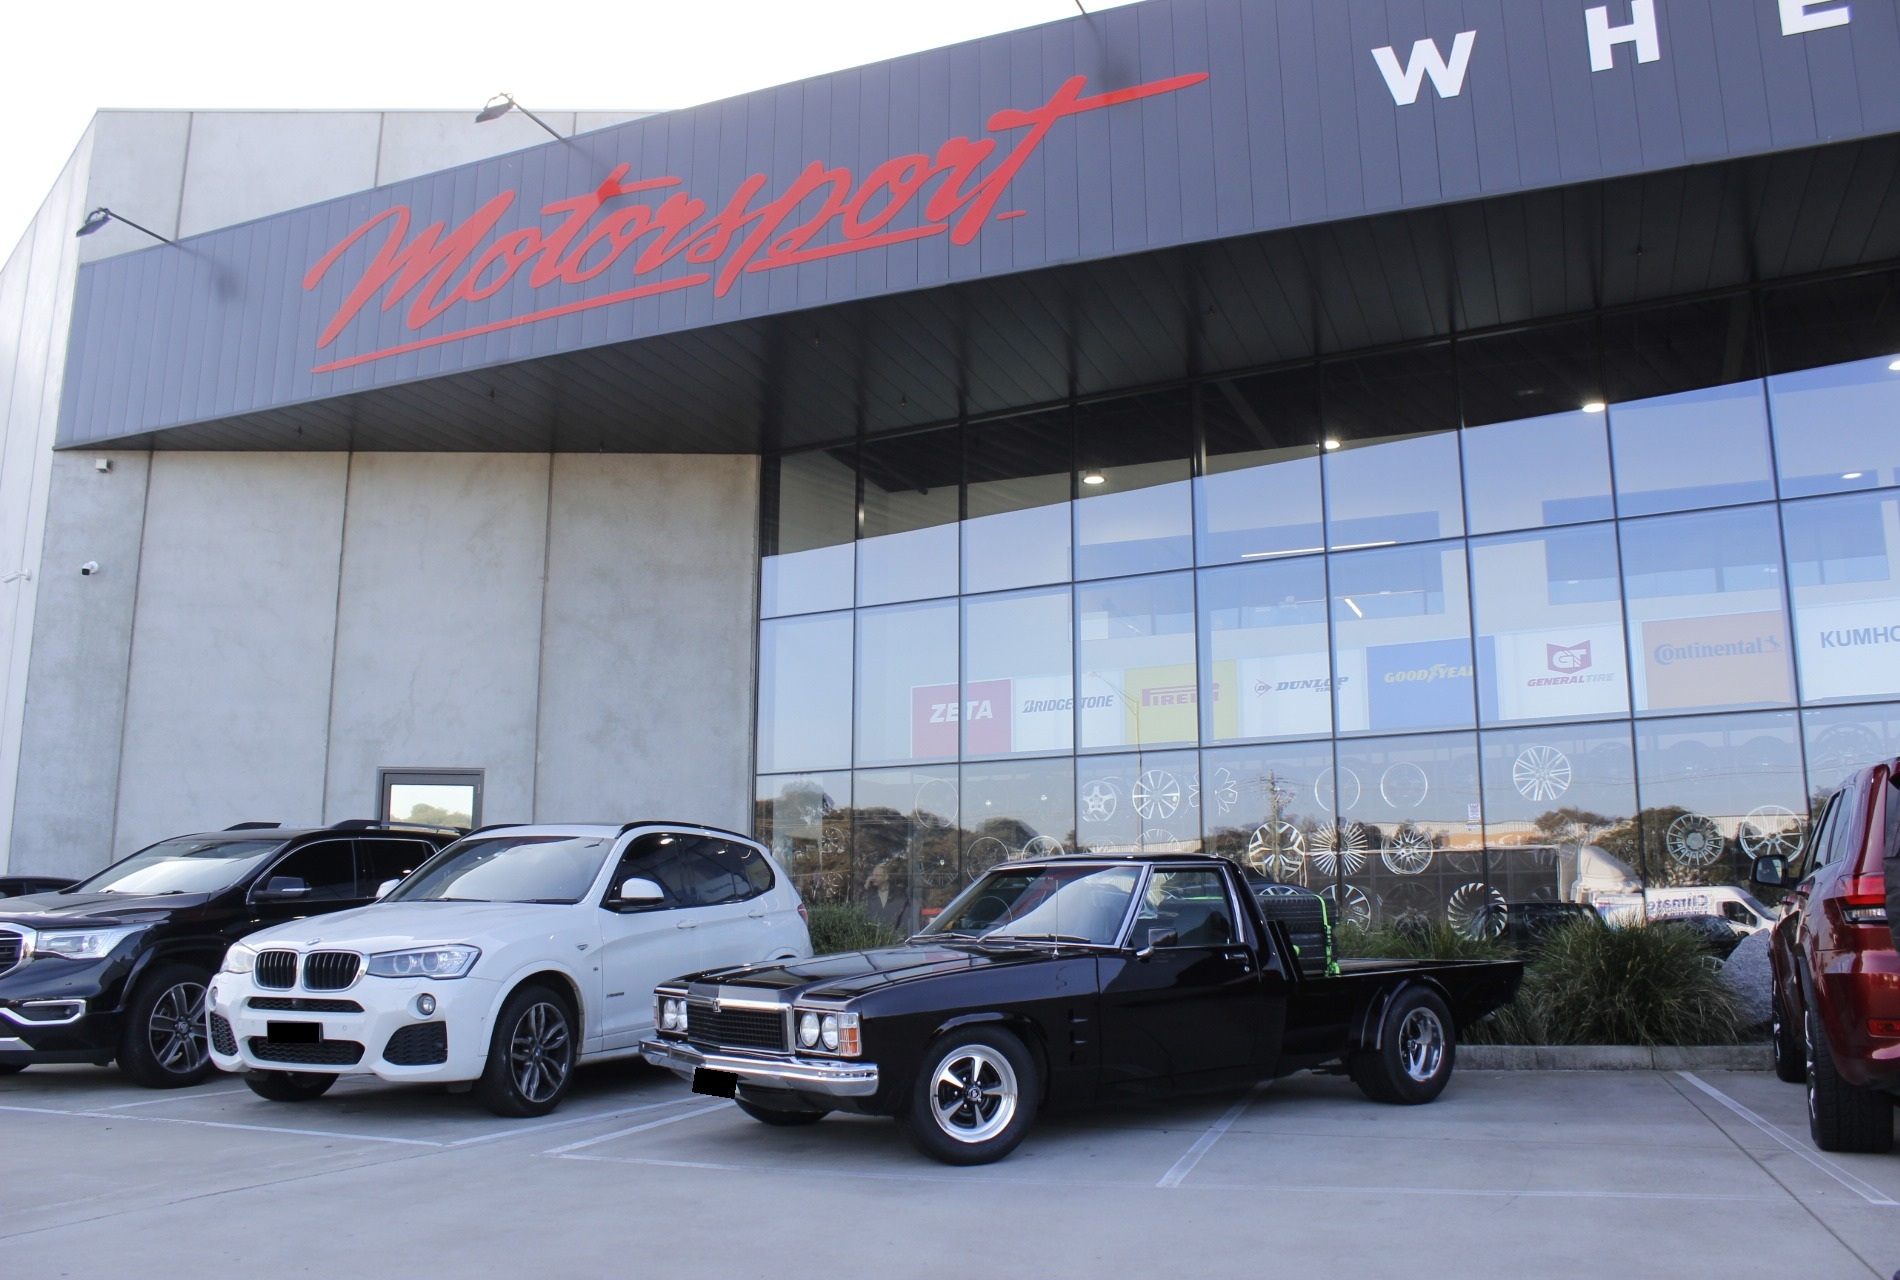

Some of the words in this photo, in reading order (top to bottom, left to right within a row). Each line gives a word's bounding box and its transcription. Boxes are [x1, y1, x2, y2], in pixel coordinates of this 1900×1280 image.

[303, 74, 1209, 352] Motorsport
[1654, 637, 1763, 666] Continental
[929, 699, 993, 723] ZETA
[1022, 695, 1114, 714] BRIDGETONE
